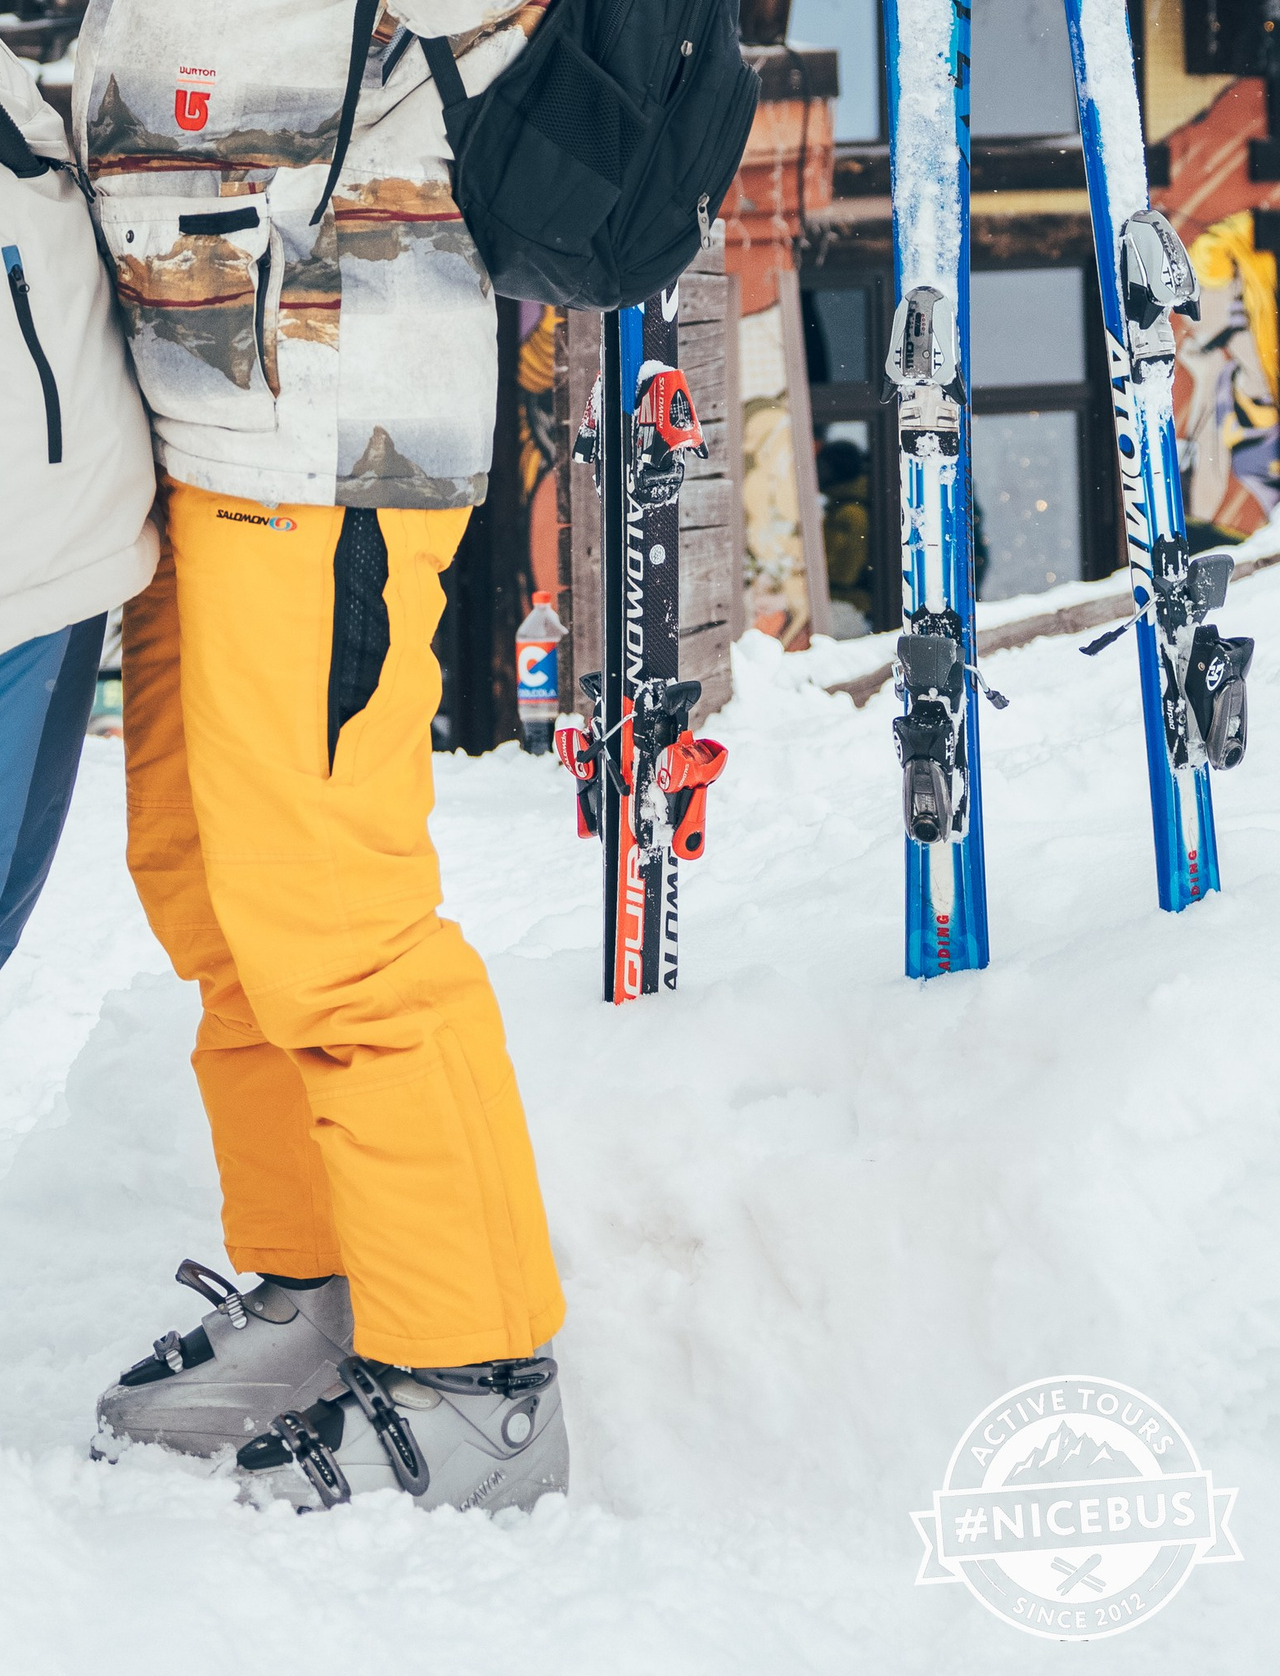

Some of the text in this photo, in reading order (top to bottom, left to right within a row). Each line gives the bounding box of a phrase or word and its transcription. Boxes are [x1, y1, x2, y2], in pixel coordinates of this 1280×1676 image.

[179, 66, 216, 76] BURTON
[657, 377, 665, 429] SALOMON
[1105, 328, 1157, 627] ATOMIC
[216, 509, 270, 526] SALOMON
[1188, 850, 1202, 902] DING
